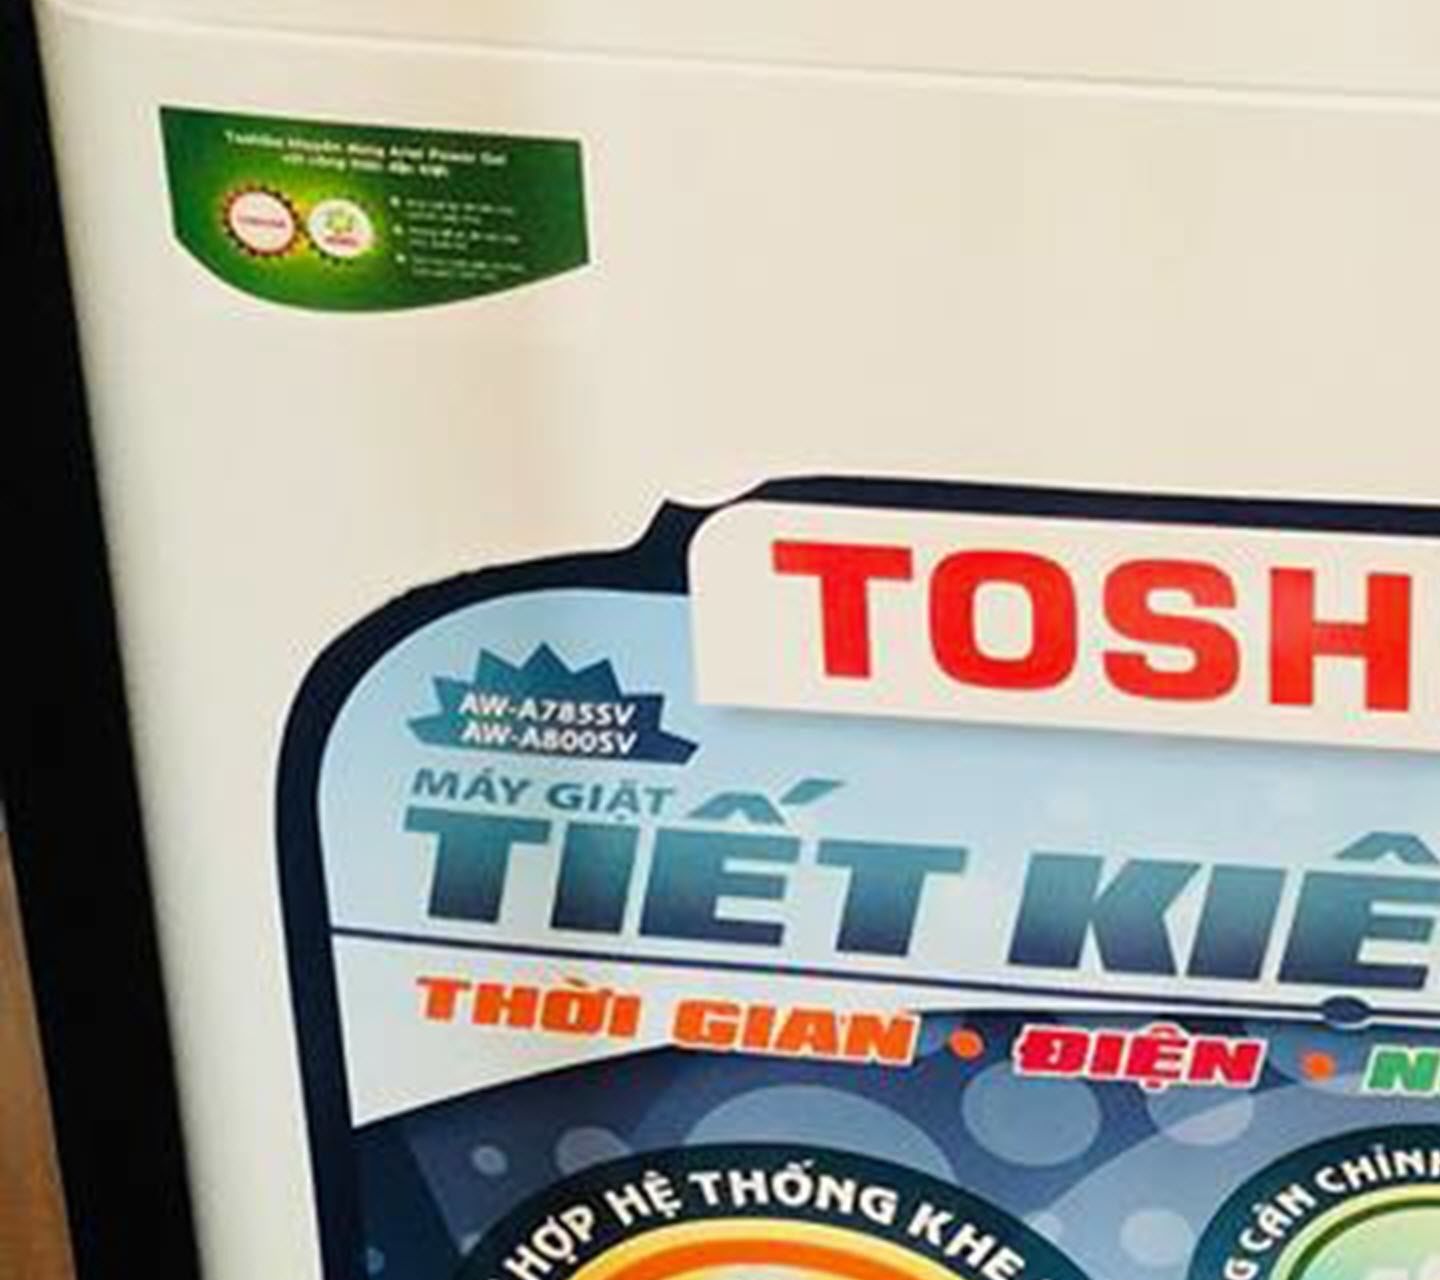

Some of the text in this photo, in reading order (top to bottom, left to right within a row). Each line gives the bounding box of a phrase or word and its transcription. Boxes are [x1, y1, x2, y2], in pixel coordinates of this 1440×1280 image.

[462, 721, 637, 755] AW-A800SV
[411, 767, 531, 806] MÁY
[403, 777, 969, 958] TIẾT
[416, 976, 641, 1038] THỜI
[672, 998, 917, 1061] GIAN
[1016, 1025, 1264, 1091] ĐIỆN
[604, 1170, 683, 1226] HỆ
[688, 1159, 899, 1225] THỐNG
